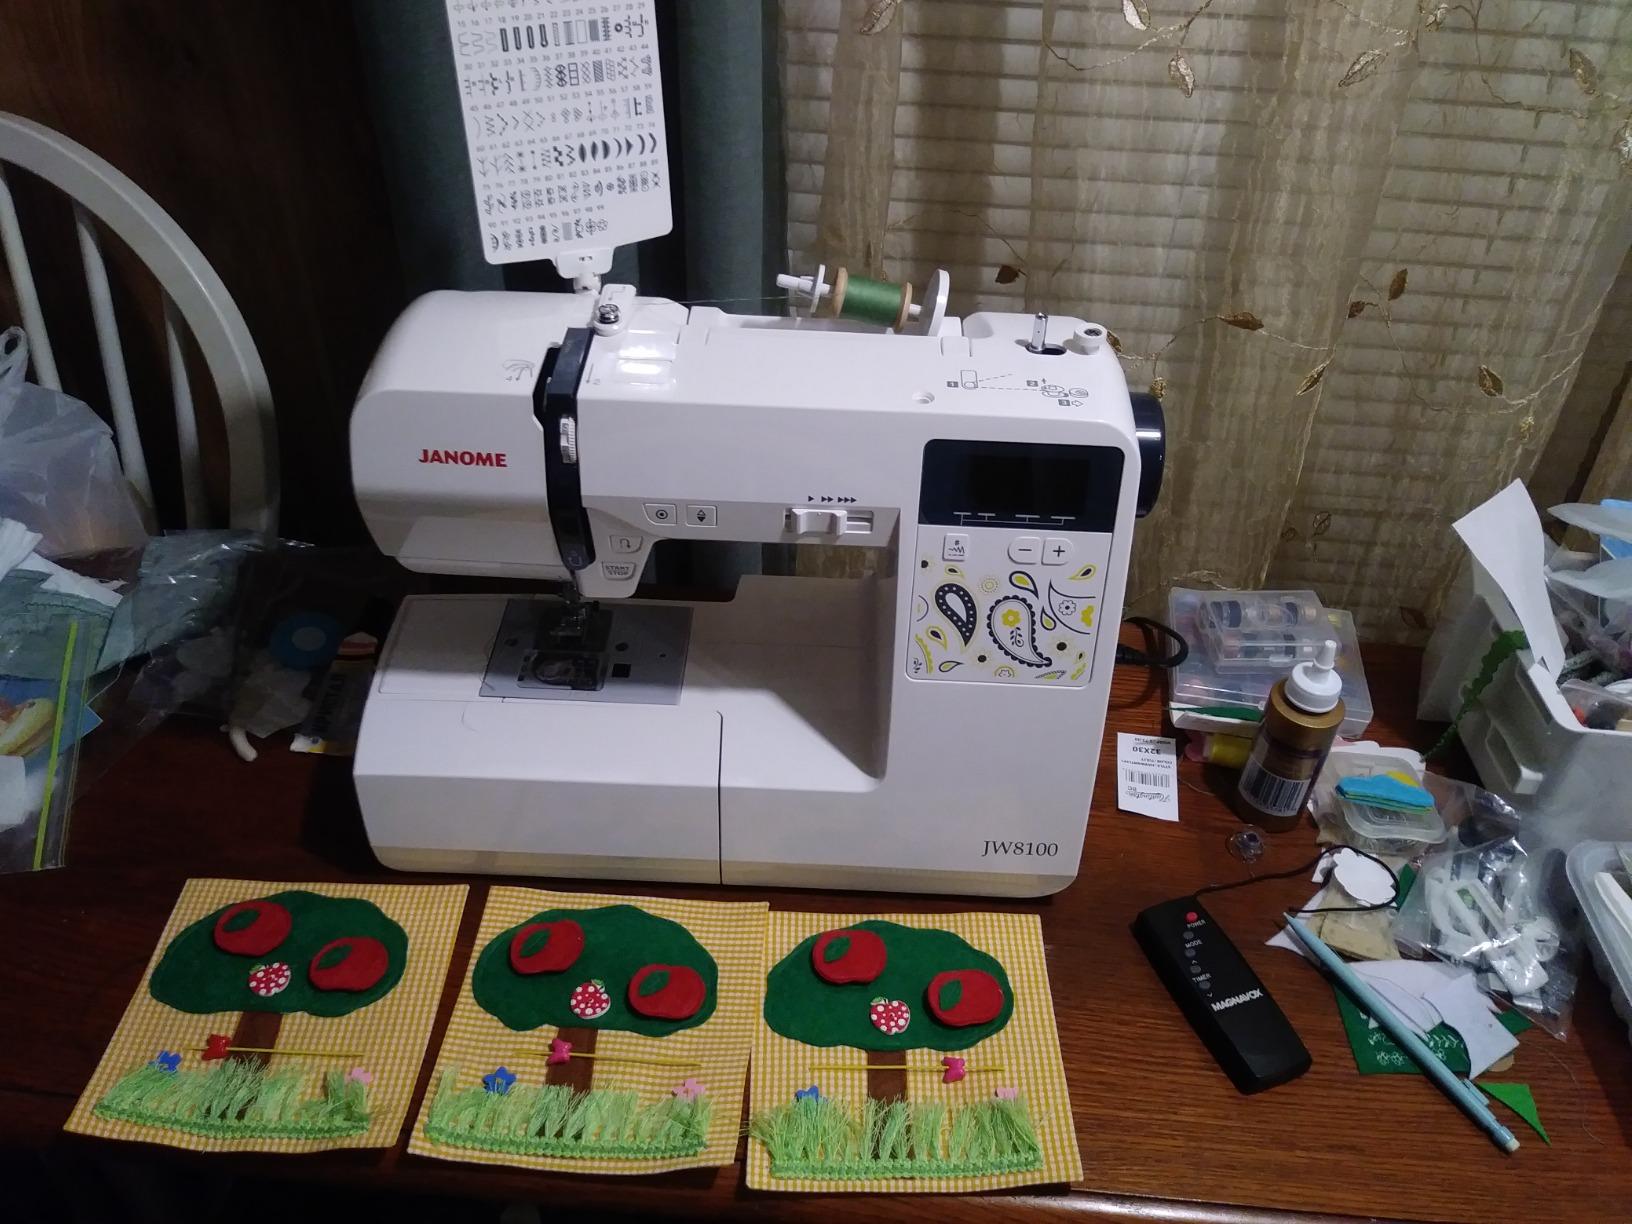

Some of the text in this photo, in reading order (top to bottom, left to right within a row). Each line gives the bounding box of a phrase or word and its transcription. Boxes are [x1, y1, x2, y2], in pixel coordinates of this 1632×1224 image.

[418, 448, 508, 468] JANOME
[1132, 746, 1161, 755] 32X30
[981, 840, 1058, 857] JW8100
[1186, 919, 1206, 928] POWER
[1185, 939, 1202, 948] MODE
[1192, 973, 1212, 983] TIMER
[1211, 988, 1264, 1012] MAGNAVOX
